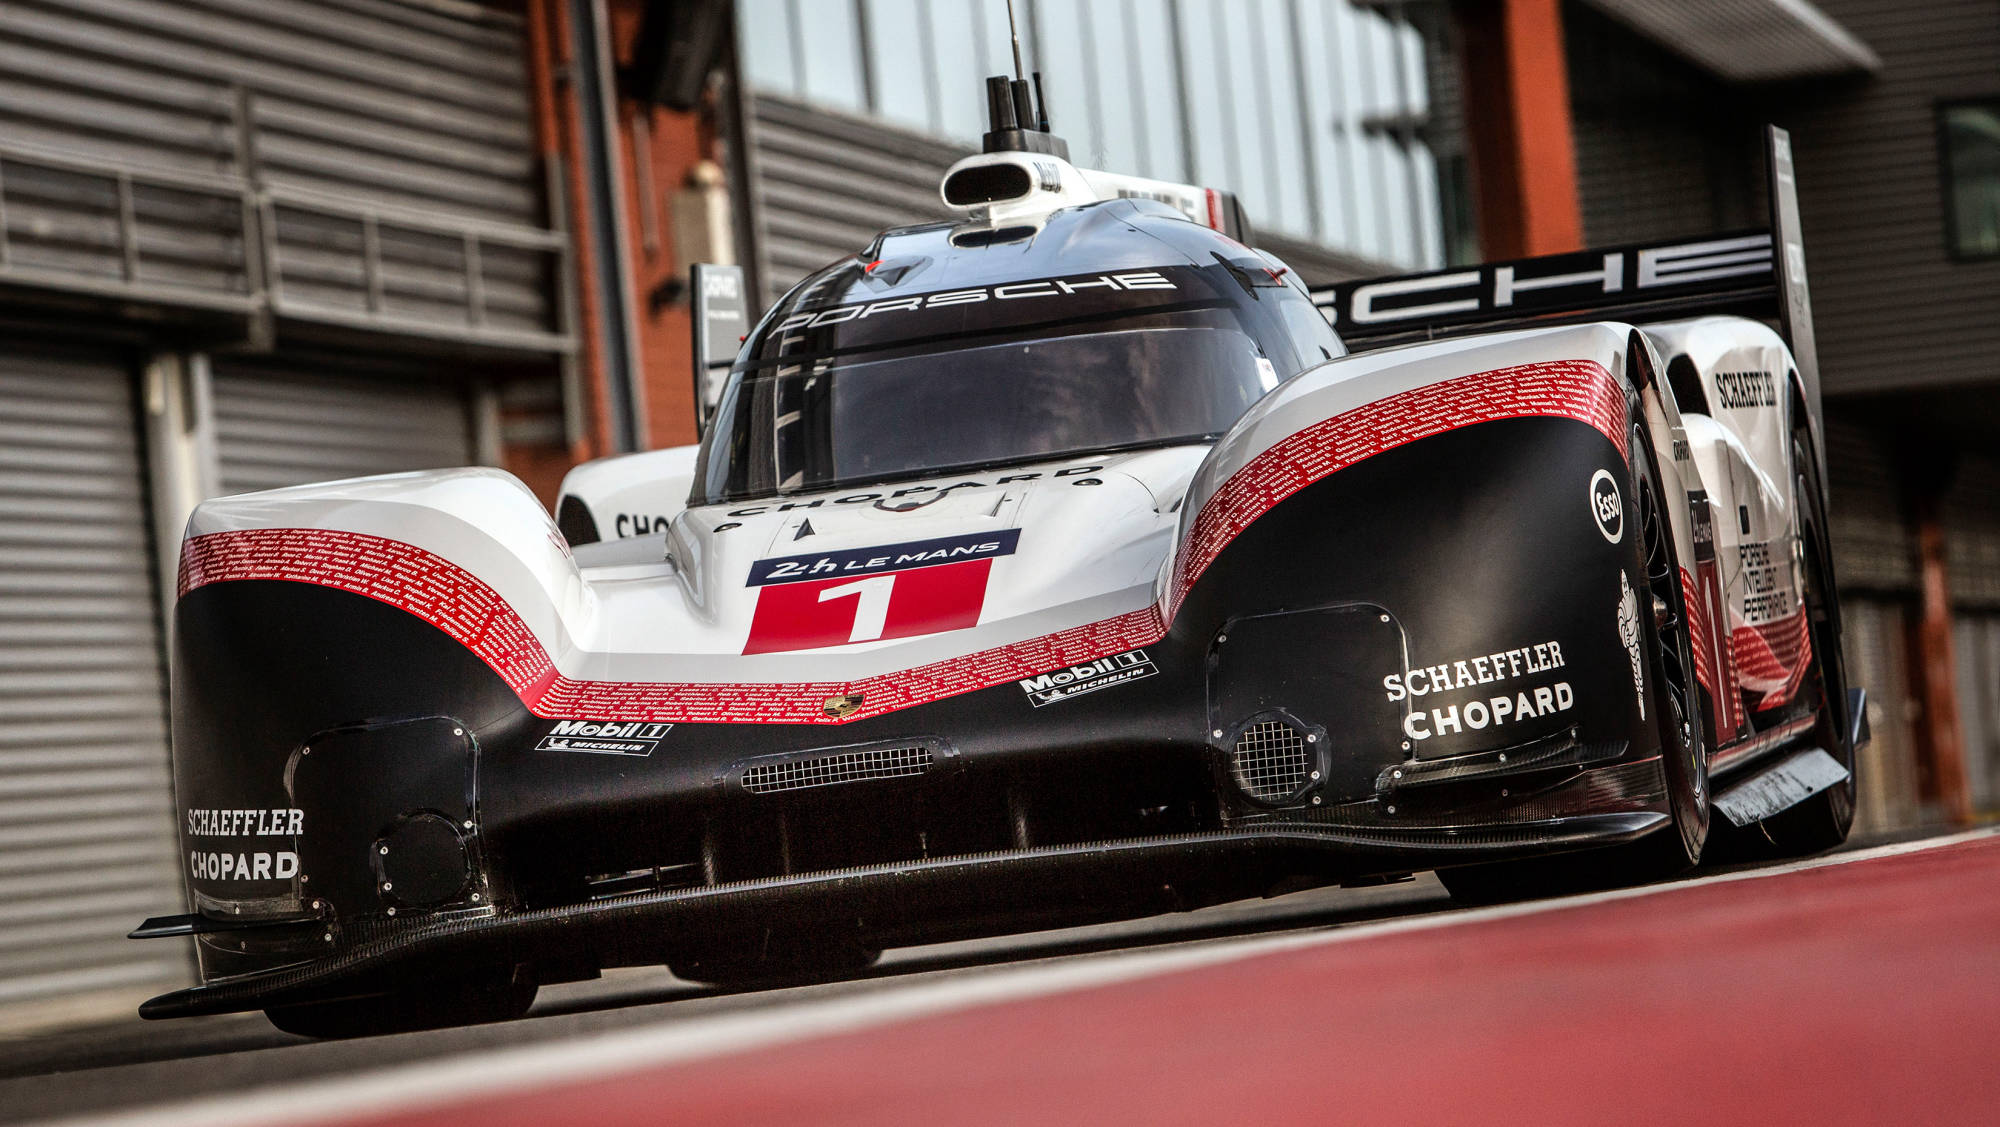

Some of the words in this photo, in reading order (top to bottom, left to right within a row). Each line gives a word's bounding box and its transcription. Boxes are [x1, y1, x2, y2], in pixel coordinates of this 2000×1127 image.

[768, 272, 1178, 338] PORSCHE
[727, 465, 1104, 517] CHOPARD
[1271, 479, 1295, 495] Martin
[1240, 509, 1262, 528] Martin
[1273, 486, 1297, 502] Martin
[1596, 492, 1620, 522] Esso
[844, 555, 890, 570] LE
[895, 541, 1001, 566] MANS
[817, 574, 897, 643] 1
[1019, 658, 1115, 694] Mobil
[1066, 668, 1144, 694] MICHELIN
[1384, 640, 1566, 702] SCHAEFFLER
[842, 710, 880, 721] Wolfgang
[1404, 682, 1574, 740] CHOPARD
[549, 720, 642, 738] Mobil
[571, 741, 646, 752] MICHELIN
[188, 808, 305, 836] SCHAEFFLER
[191, 850, 300, 881] CHOPARD
